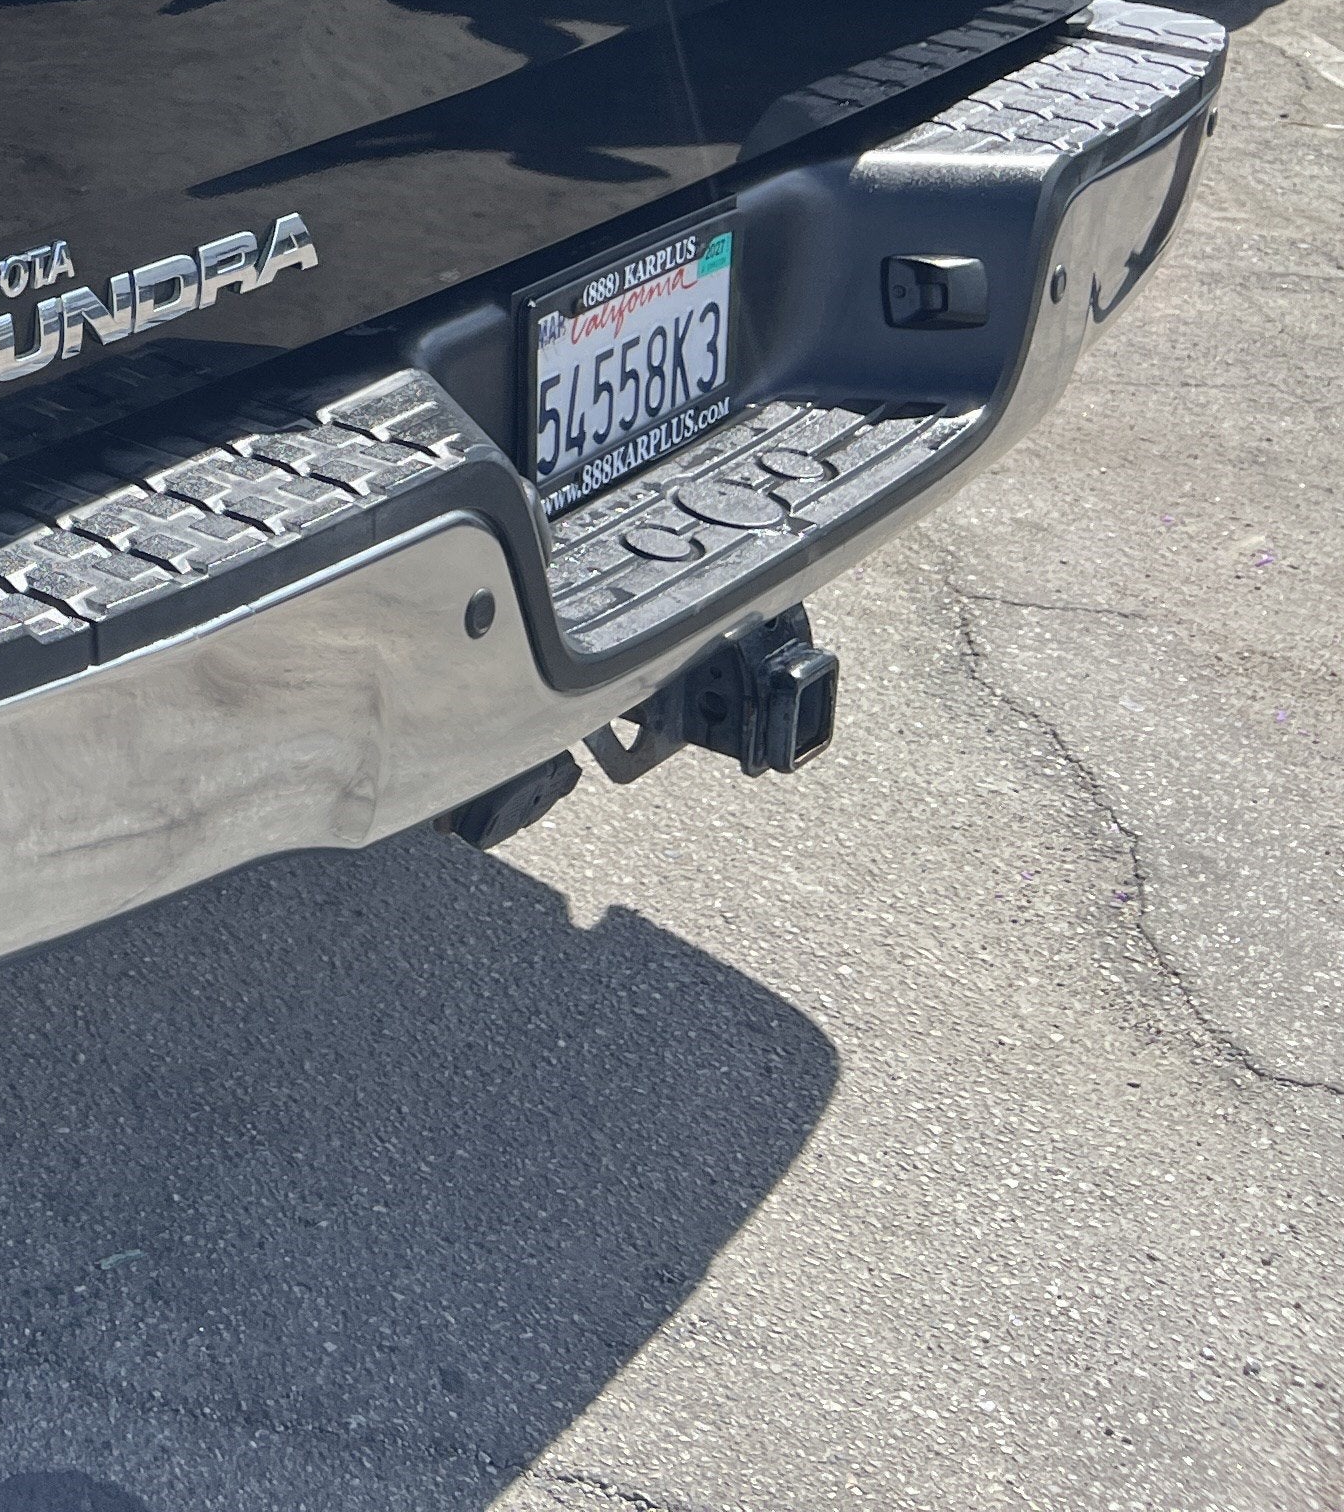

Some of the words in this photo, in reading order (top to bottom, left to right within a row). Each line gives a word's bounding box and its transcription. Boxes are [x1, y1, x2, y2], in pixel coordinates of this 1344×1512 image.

[572, 266, 699, 345] California
[583, 272, 620, 307] (888)
[624, 235, 697, 290] KARPLUS
[537, 301, 721, 476] 54558K3
